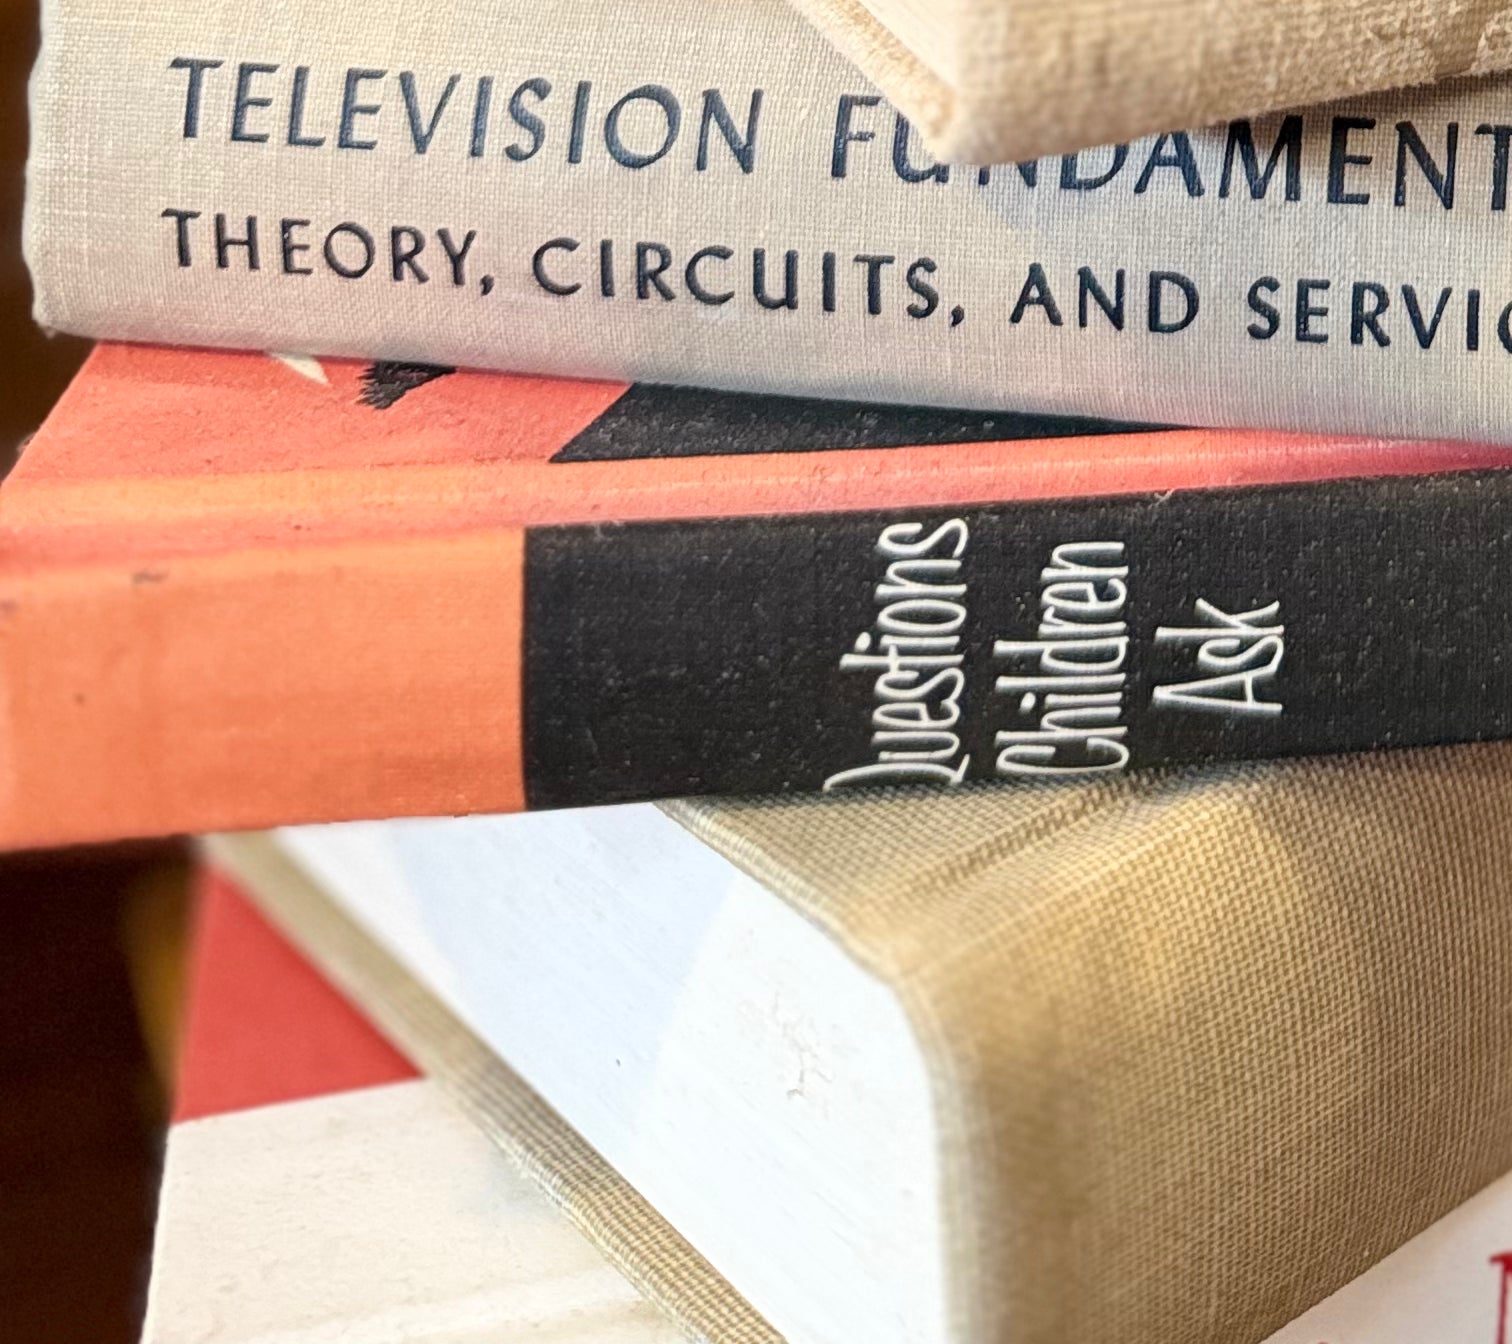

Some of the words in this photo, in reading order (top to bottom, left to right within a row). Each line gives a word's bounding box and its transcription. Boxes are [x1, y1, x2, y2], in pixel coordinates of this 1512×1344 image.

[169, 56, 765, 175] TELEVISION
[160, 207, 496, 297] THEORY,
[531, 236, 967, 328] CIRCUITS,
[1008, 261, 1201, 334] AND
[993, 540, 1129, 776] Children
[1152, 598, 1284, 714] Ask
